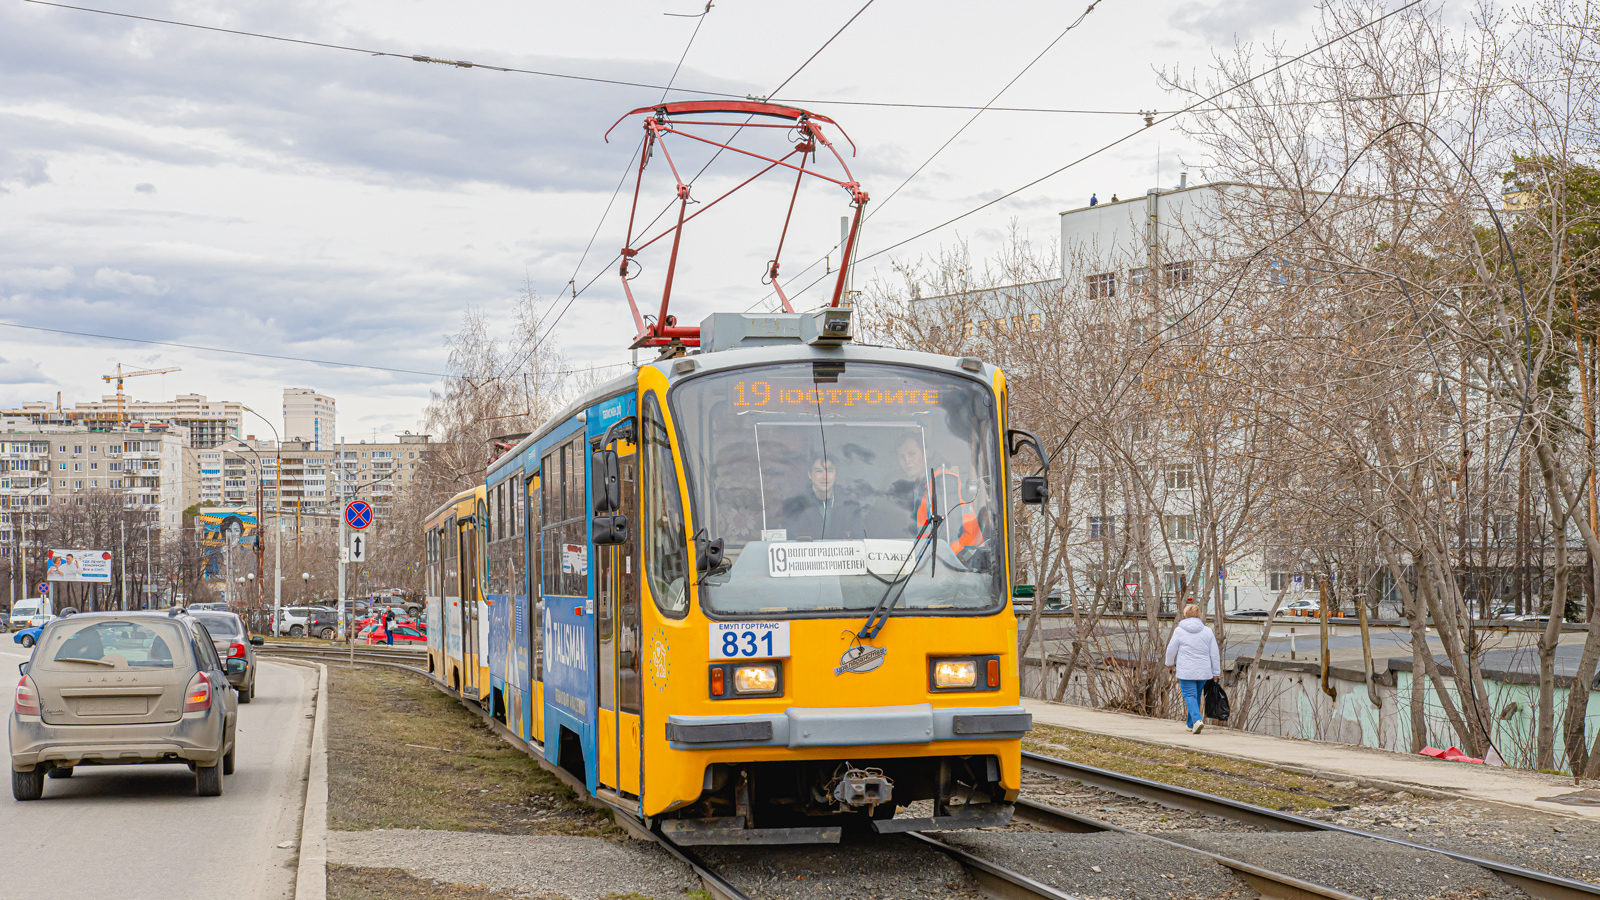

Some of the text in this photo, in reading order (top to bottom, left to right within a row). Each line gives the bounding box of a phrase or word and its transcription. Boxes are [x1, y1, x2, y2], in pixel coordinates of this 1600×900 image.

[733, 381, 771, 406] 19
[769, 547, 788, 573] 19
[718, 622, 780, 631] ЕМУП ГОРТРАНС
[553, 622, 586, 671] TALISMAN
[722, 630, 773, 657] 831
